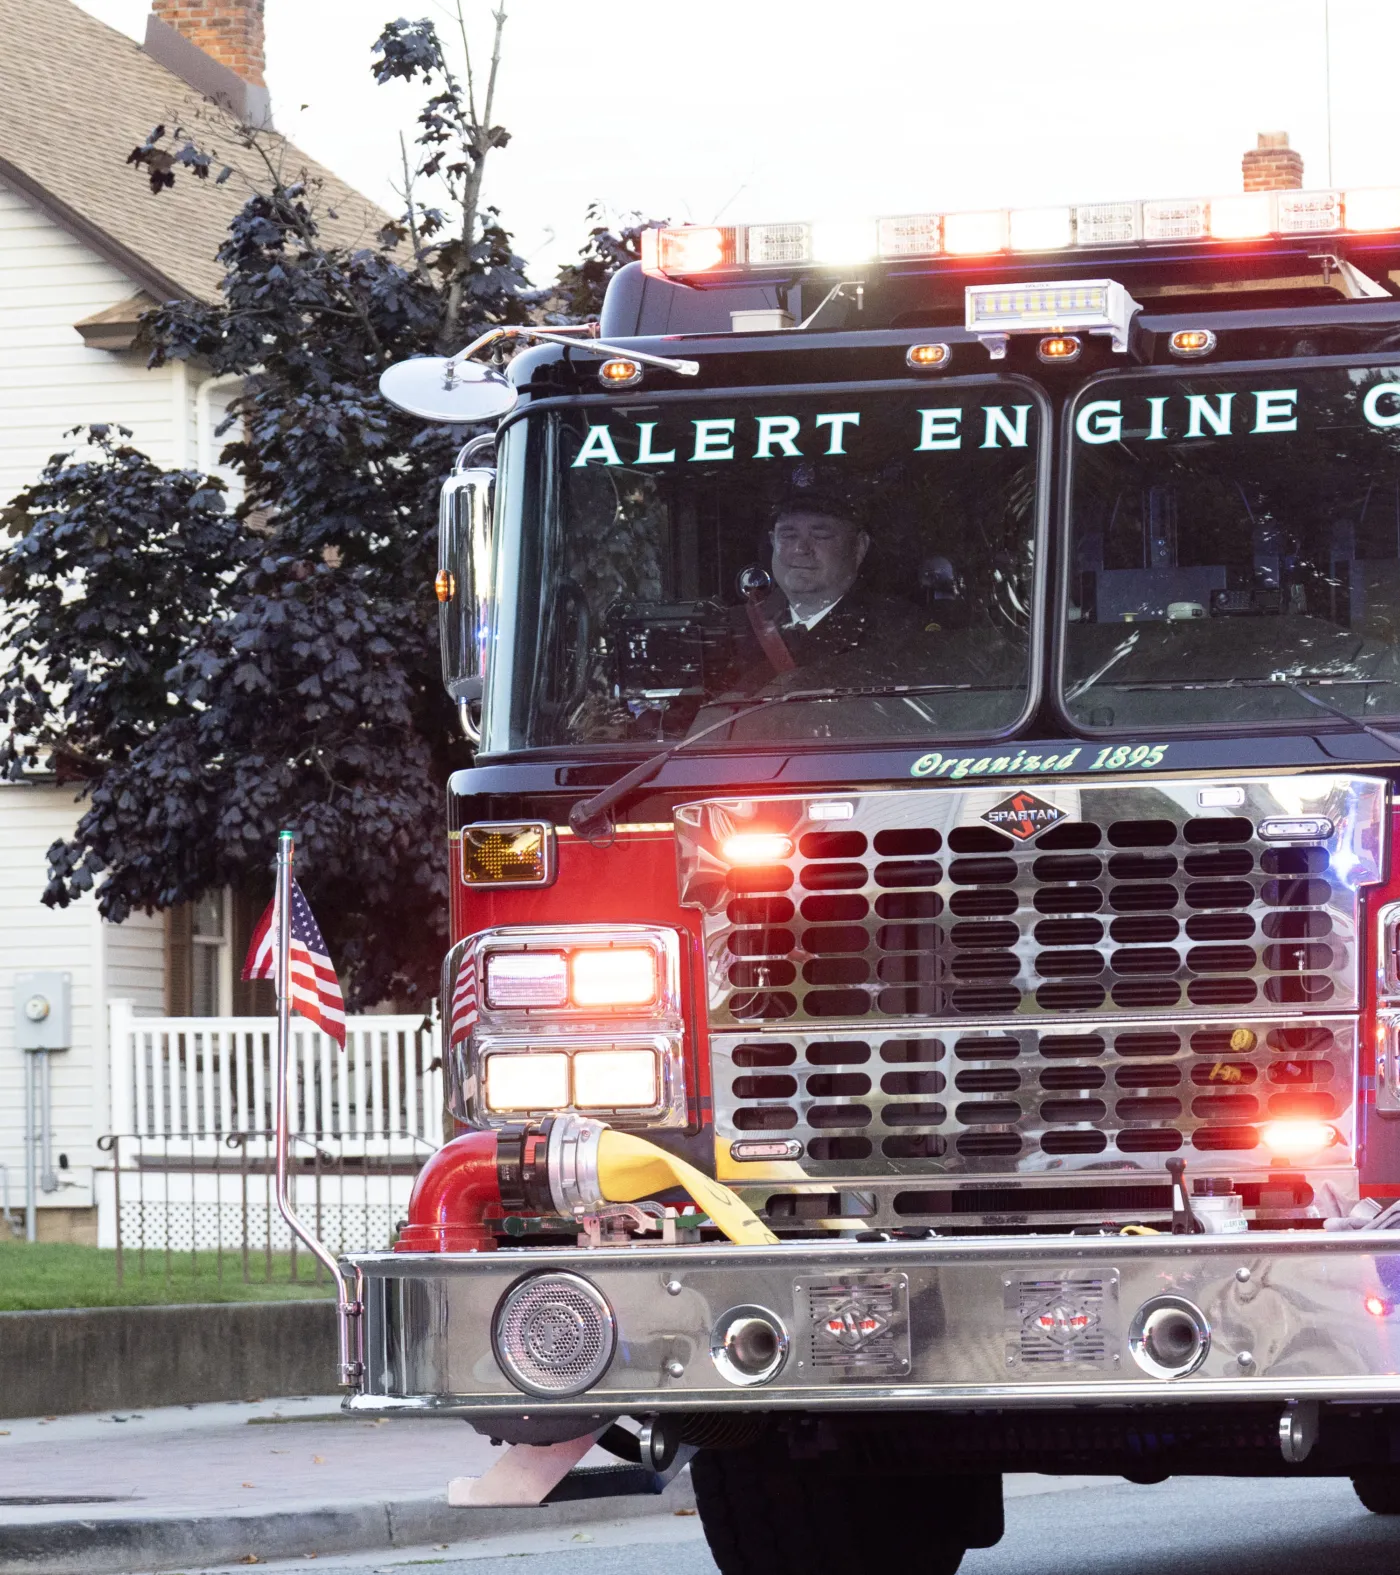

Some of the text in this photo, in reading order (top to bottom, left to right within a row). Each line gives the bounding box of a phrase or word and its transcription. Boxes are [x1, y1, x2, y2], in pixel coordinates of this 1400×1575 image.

[570, 412, 861, 467] ALERT
[910, 744, 1170, 779] Organized 1895
[988, 808, 1058, 822] SPARTAN
